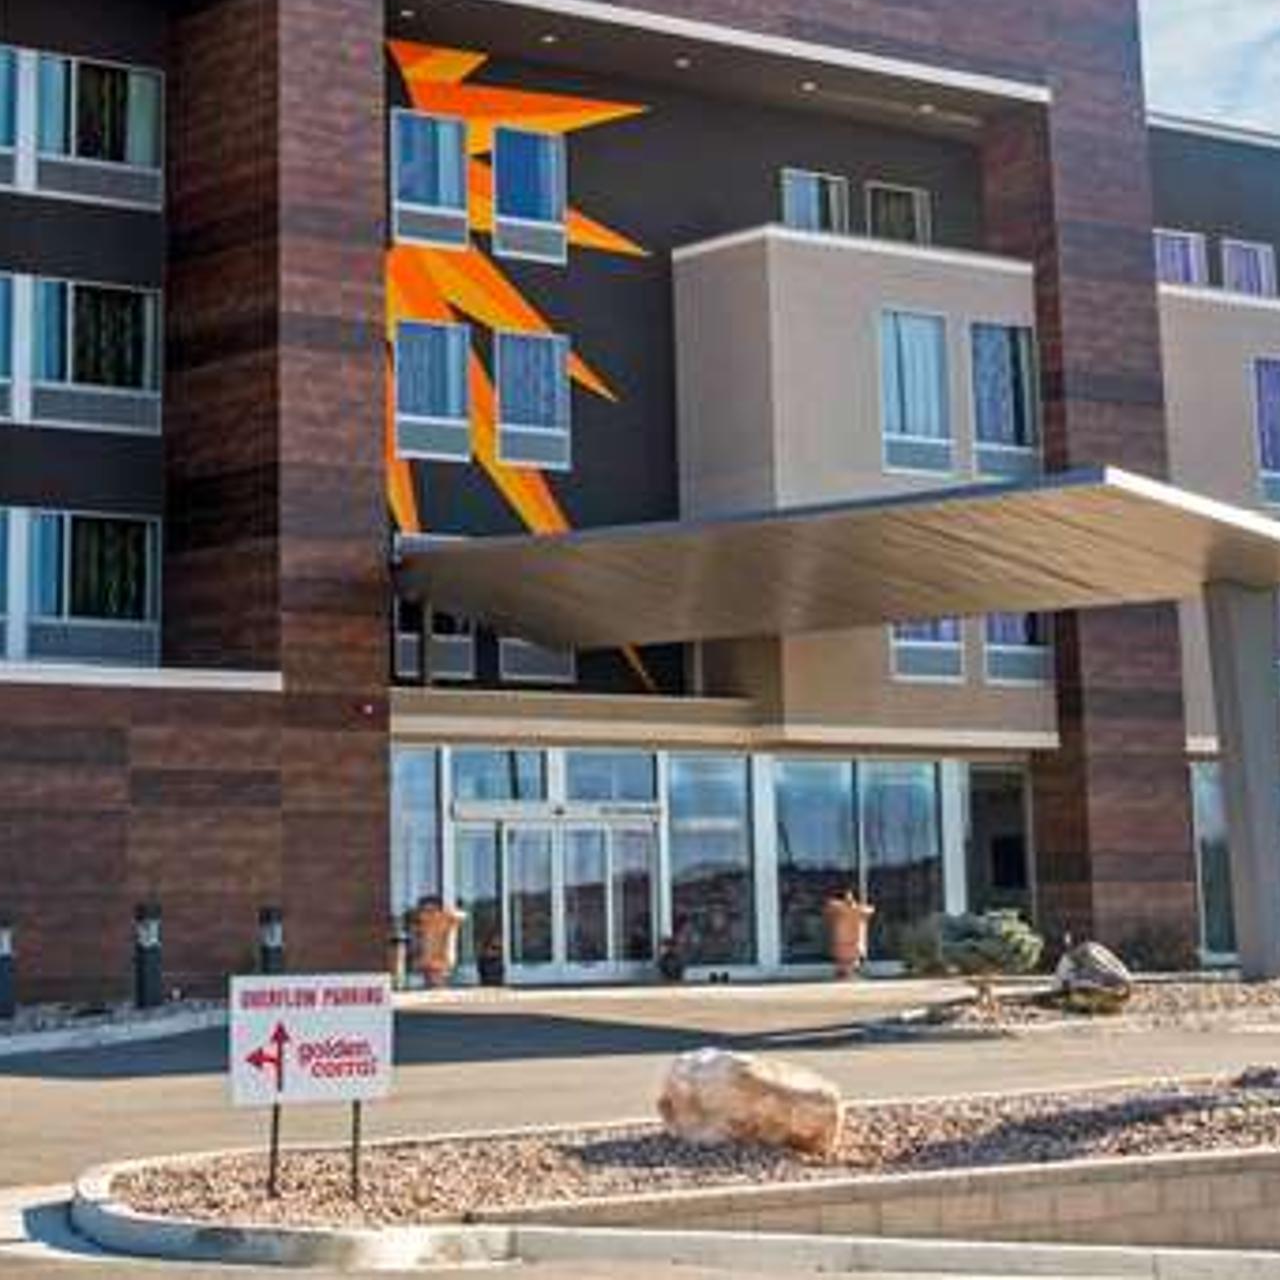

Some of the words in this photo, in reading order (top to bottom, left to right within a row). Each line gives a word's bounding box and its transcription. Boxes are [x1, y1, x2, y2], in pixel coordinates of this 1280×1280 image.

[240, 988, 317, 1011] OVERFLOW
[322, 985, 384, 1007] PARKING
[296, 1035, 372, 1067] golden
